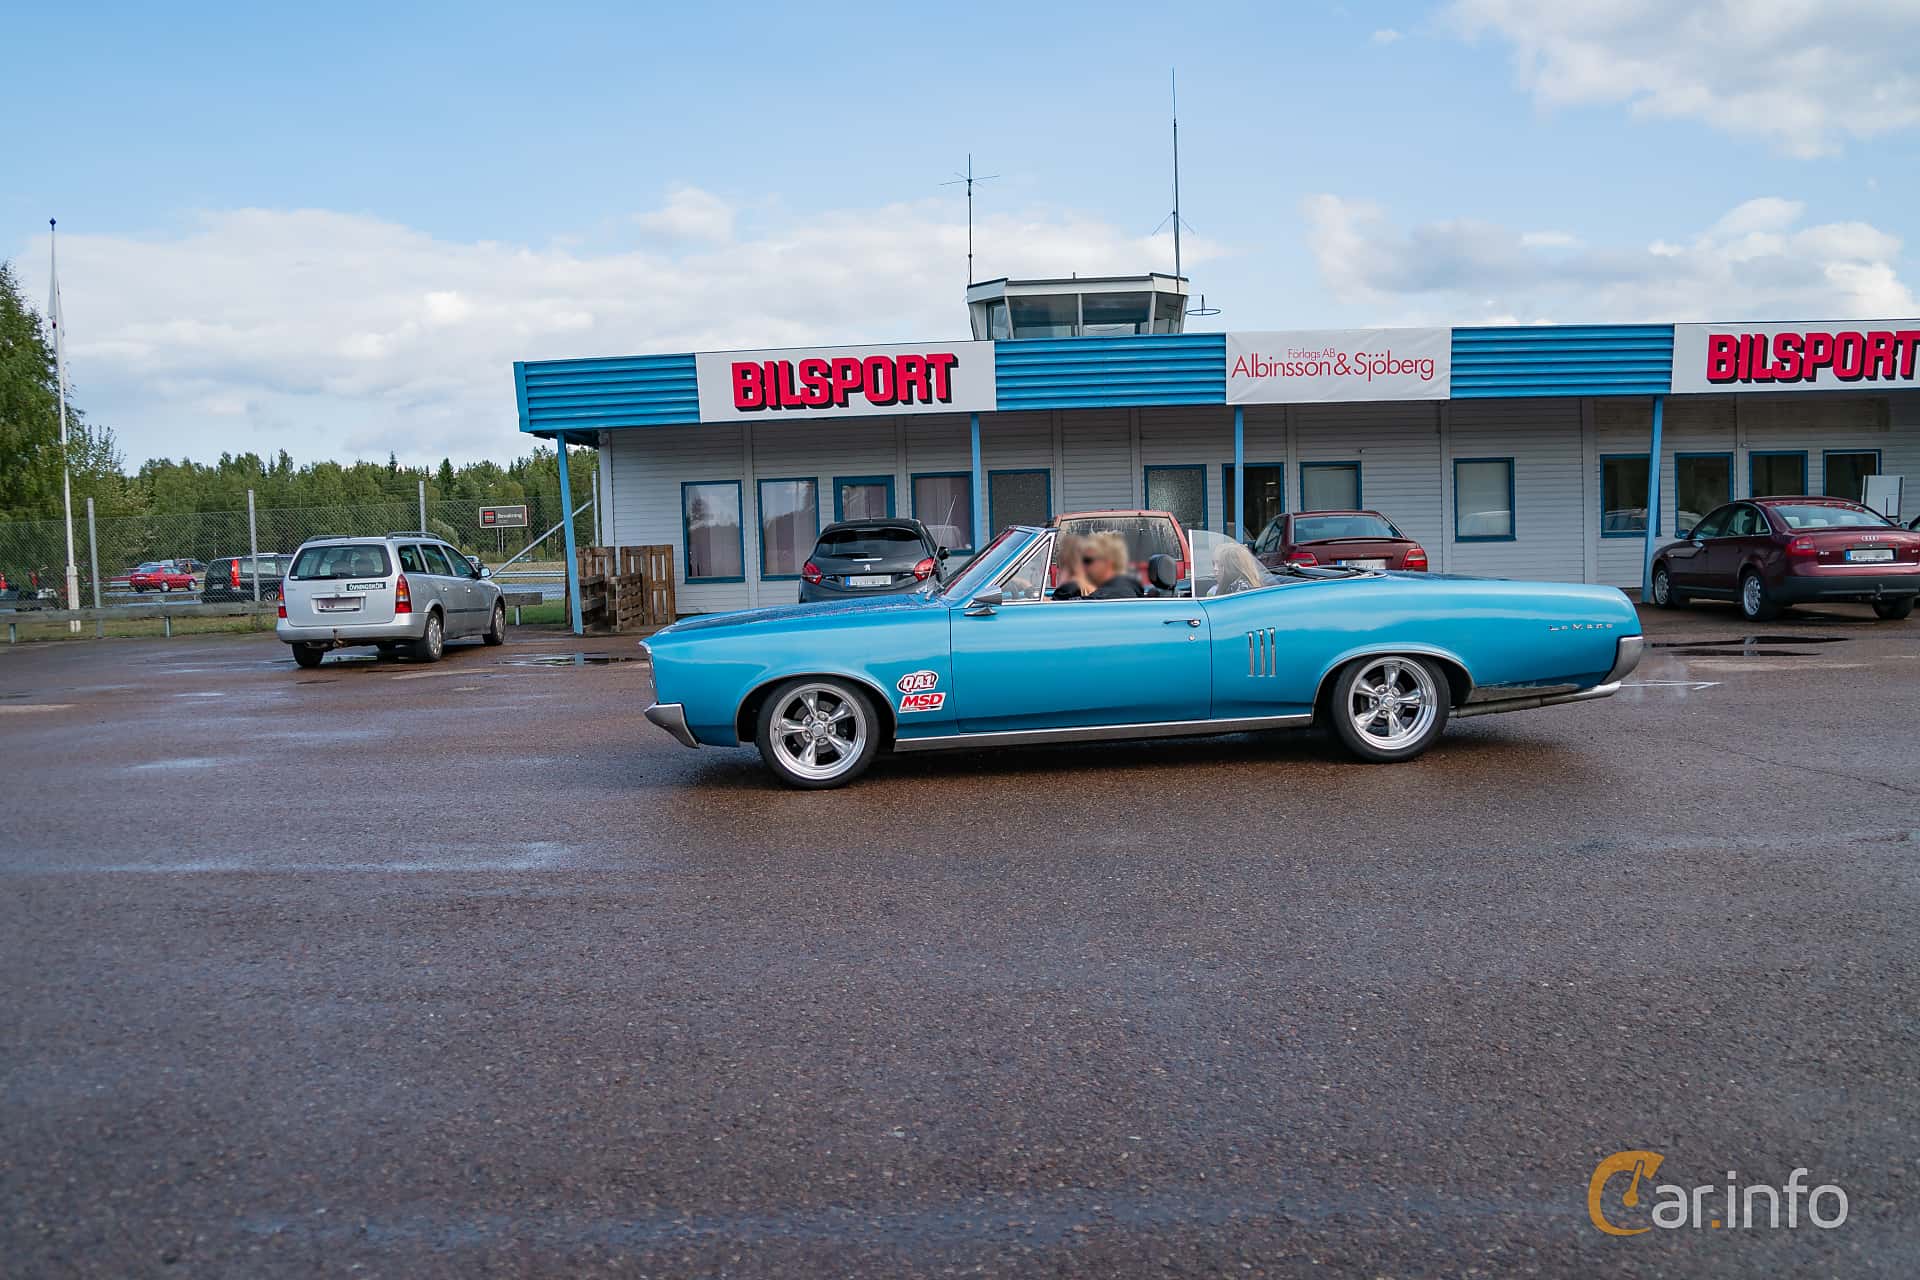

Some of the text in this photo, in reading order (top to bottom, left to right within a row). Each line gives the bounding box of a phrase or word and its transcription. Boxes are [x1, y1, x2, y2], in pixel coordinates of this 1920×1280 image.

[1287, 348, 1336, 361] Förlags AB
[1707, 330, 1920, 384] BILSPORT
[731, 353, 959, 412] BILSPORT
[901, 693, 943, 708] MSD
